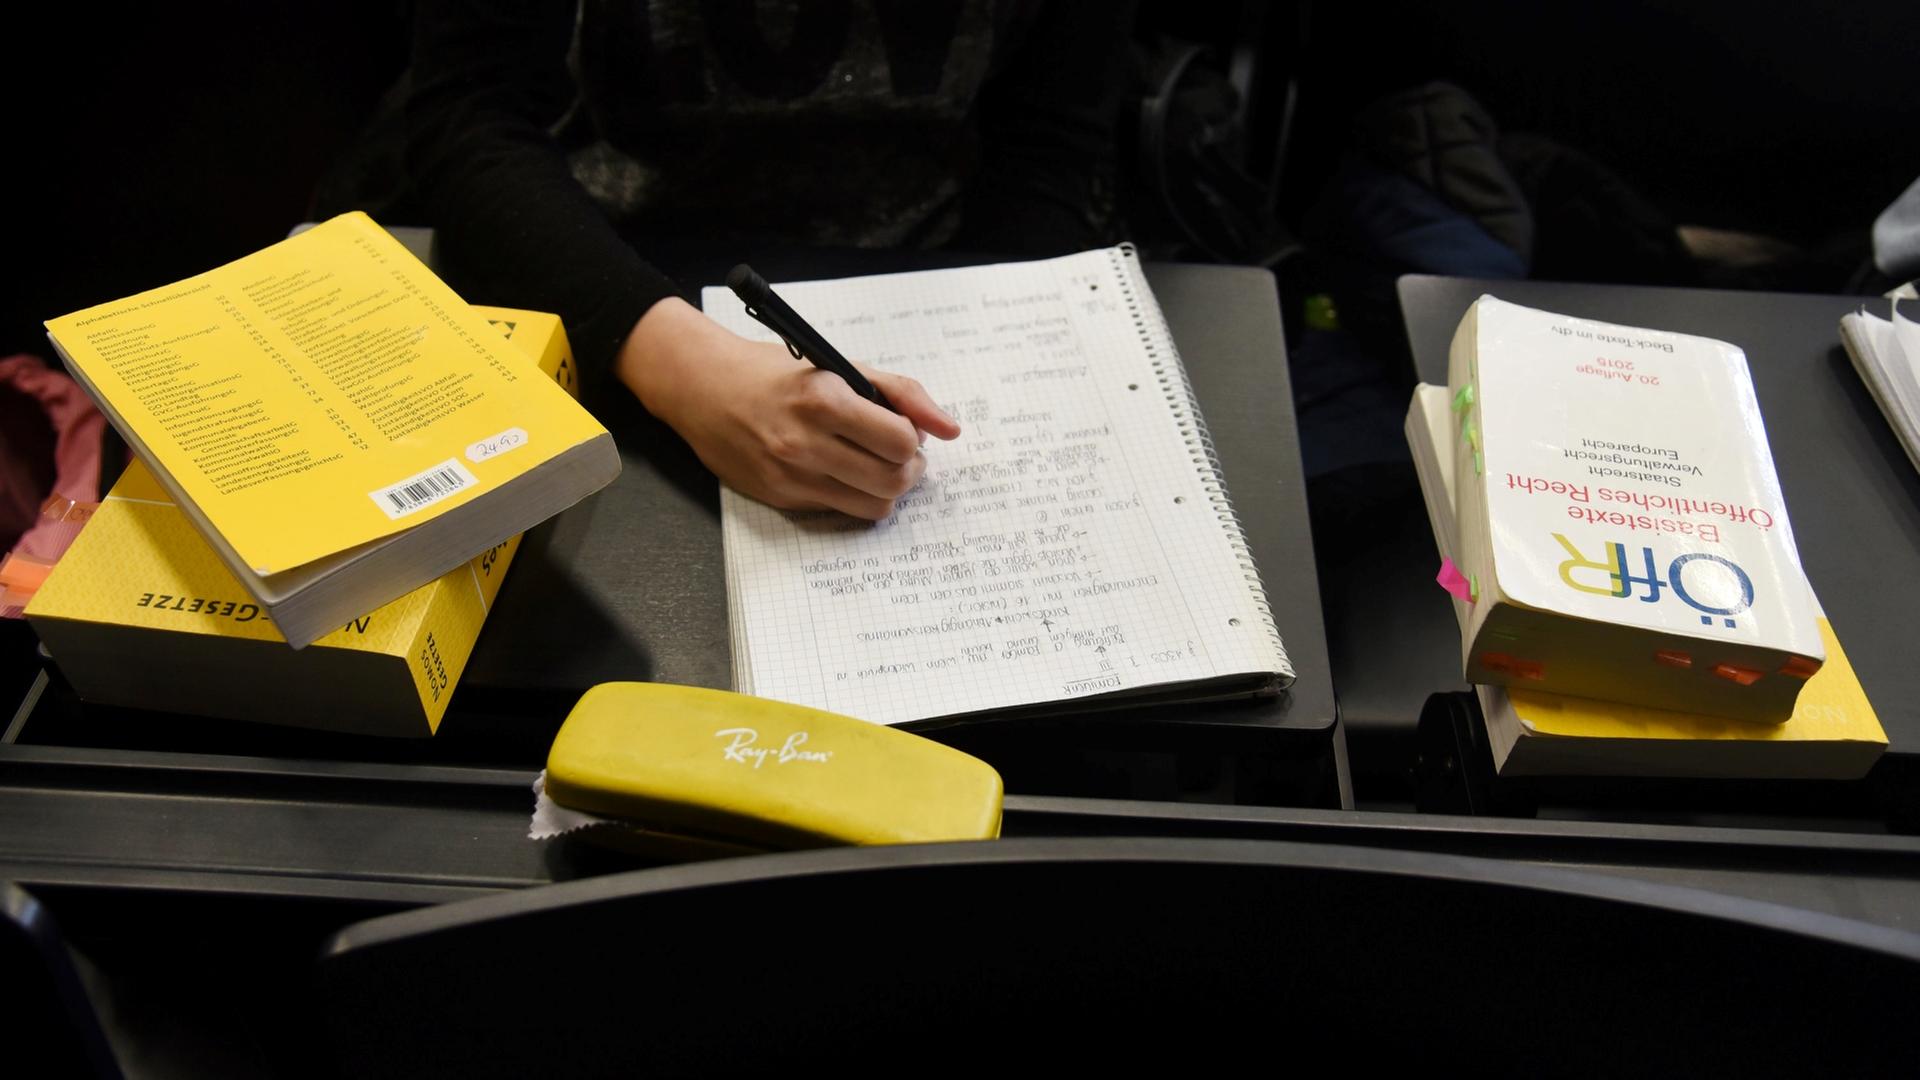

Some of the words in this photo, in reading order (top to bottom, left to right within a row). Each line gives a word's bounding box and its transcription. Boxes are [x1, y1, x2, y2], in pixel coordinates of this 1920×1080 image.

[74, 305, 140, 328] Alphabetische
[140, 283, 212, 308] Schnellübersicht
[1551, 325, 1573, 336] dtv
[1576, 330, 1593, 339] im
[95, 333, 151, 352] Bauordnung
[301, 332, 348, 354] Verfassung
[1597, 332, 1675, 353] Beck-Texte
[1575, 364, 1633, 383] Auflage
[1596, 356, 1634, 371] 2015
[137, 379, 196, 400] GaststättenG
[345, 384, 375, 399] WahlG
[1635, 374, 1660, 386] 20.
[146, 403, 163, 411] GO
[163, 392, 201, 407] Landtag
[356, 392, 394, 410] WasserG
[363, 383, 435, 419] ZuständigkeitsVO
[431, 371, 458, 386] Abfall
[369, 389, 441, 424] ZuständigkeitsVO
[438, 372, 475, 392] Gewerbe
[375, 394, 447, 430] ZuständigkeitsVO
[444, 385, 465, 398] Kom
[380, 400, 453, 436] ZuständigkeitsVO
[449, 391, 470, 403] SOG
[386, 406, 459, 442] ZuständigkeitsVO
[455, 391, 486, 408] Wasser
[182, 432, 237, 452] Kommunale
[1581, 437, 1679, 460] Europarecht
[1562, 449, 1703, 477] Verwaltungsrecht
[1506, 472, 1590, 503] Recht
[1589, 465, 1682, 488] Staatsrecht
[1599, 488, 1774, 532] Öffentliches
[1567, 505, 1720, 543] Basistexte
[1551, 532, 1755, 629] ÖffR
[426, 631, 448, 689] GESETZE
[420, 649, 440, 703] NOMOS
[714, 727, 832, 769] Ray-Ban
